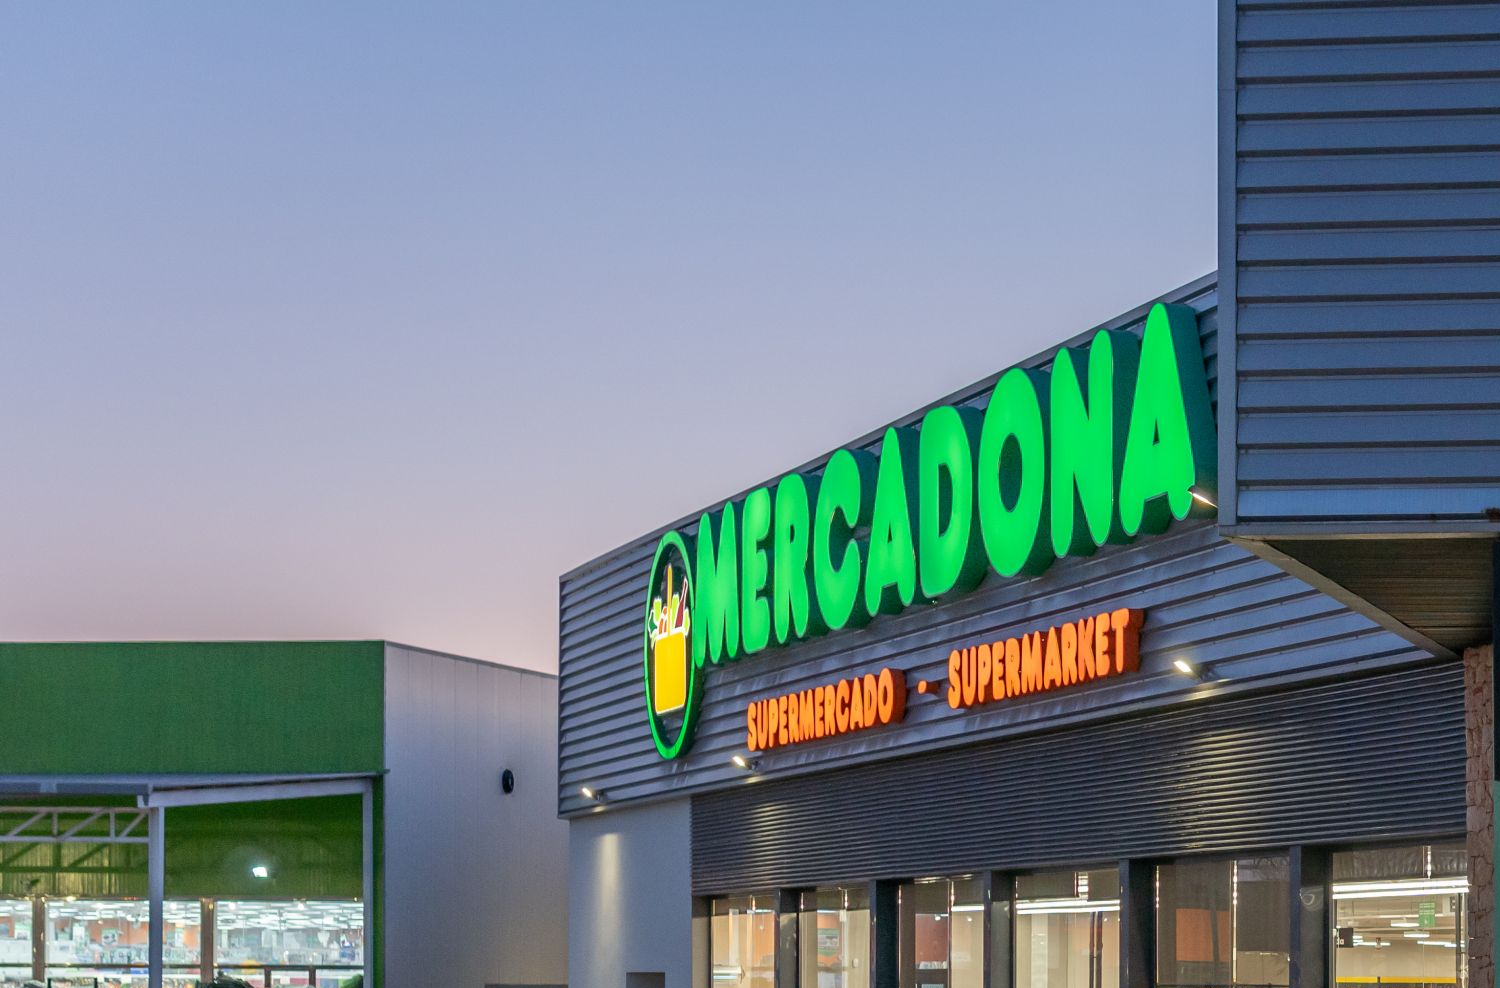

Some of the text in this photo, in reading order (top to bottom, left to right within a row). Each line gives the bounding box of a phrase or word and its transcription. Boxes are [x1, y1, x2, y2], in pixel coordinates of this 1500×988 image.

[691, 302, 1196, 668] MERCADONA
[747, 607, 1131, 751] SUPERMERCADO SUPERMARKET
